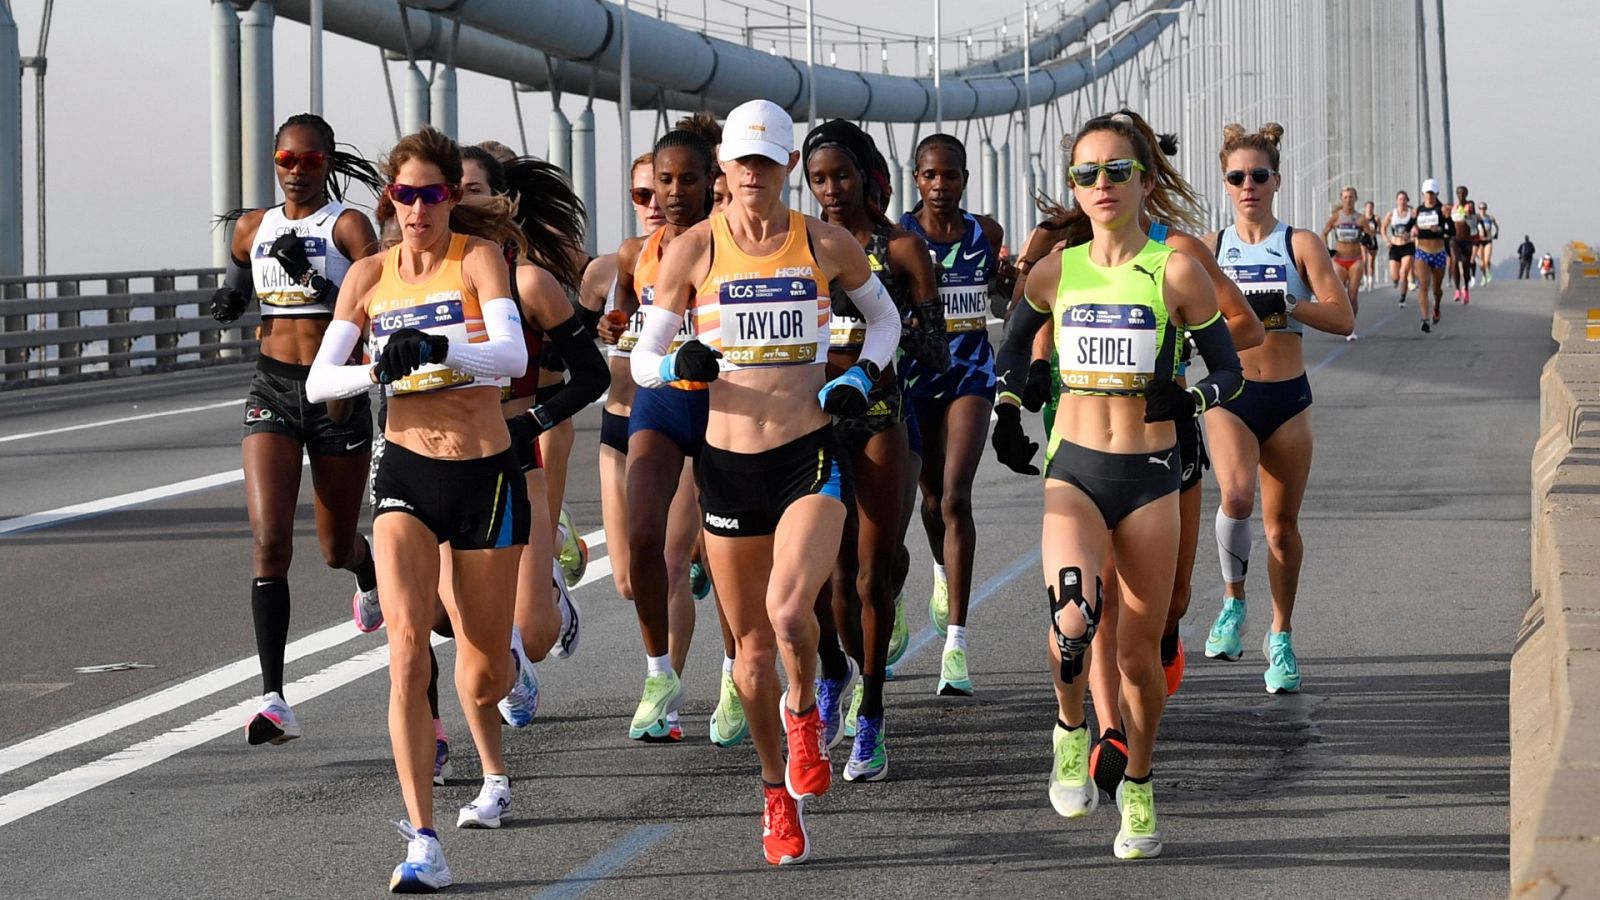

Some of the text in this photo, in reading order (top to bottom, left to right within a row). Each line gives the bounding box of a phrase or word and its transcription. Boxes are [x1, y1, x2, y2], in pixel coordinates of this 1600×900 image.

[734, 272, 760, 280] ELITE
[775, 266, 814, 278] HOKA
[425, 290, 462, 304] HOKA
[728, 284, 754, 298] tcs
[380, 315, 403, 330] tcs
[1071, 308, 1095, 323] tcs
[735, 309, 804, 340] TAYLOR
[723, 350, 754, 361] 2021
[1077, 336, 1137, 366] SEIDEL
[1061, 374, 1090, 386] 2021
[706, 512, 739, 529] HOKA
